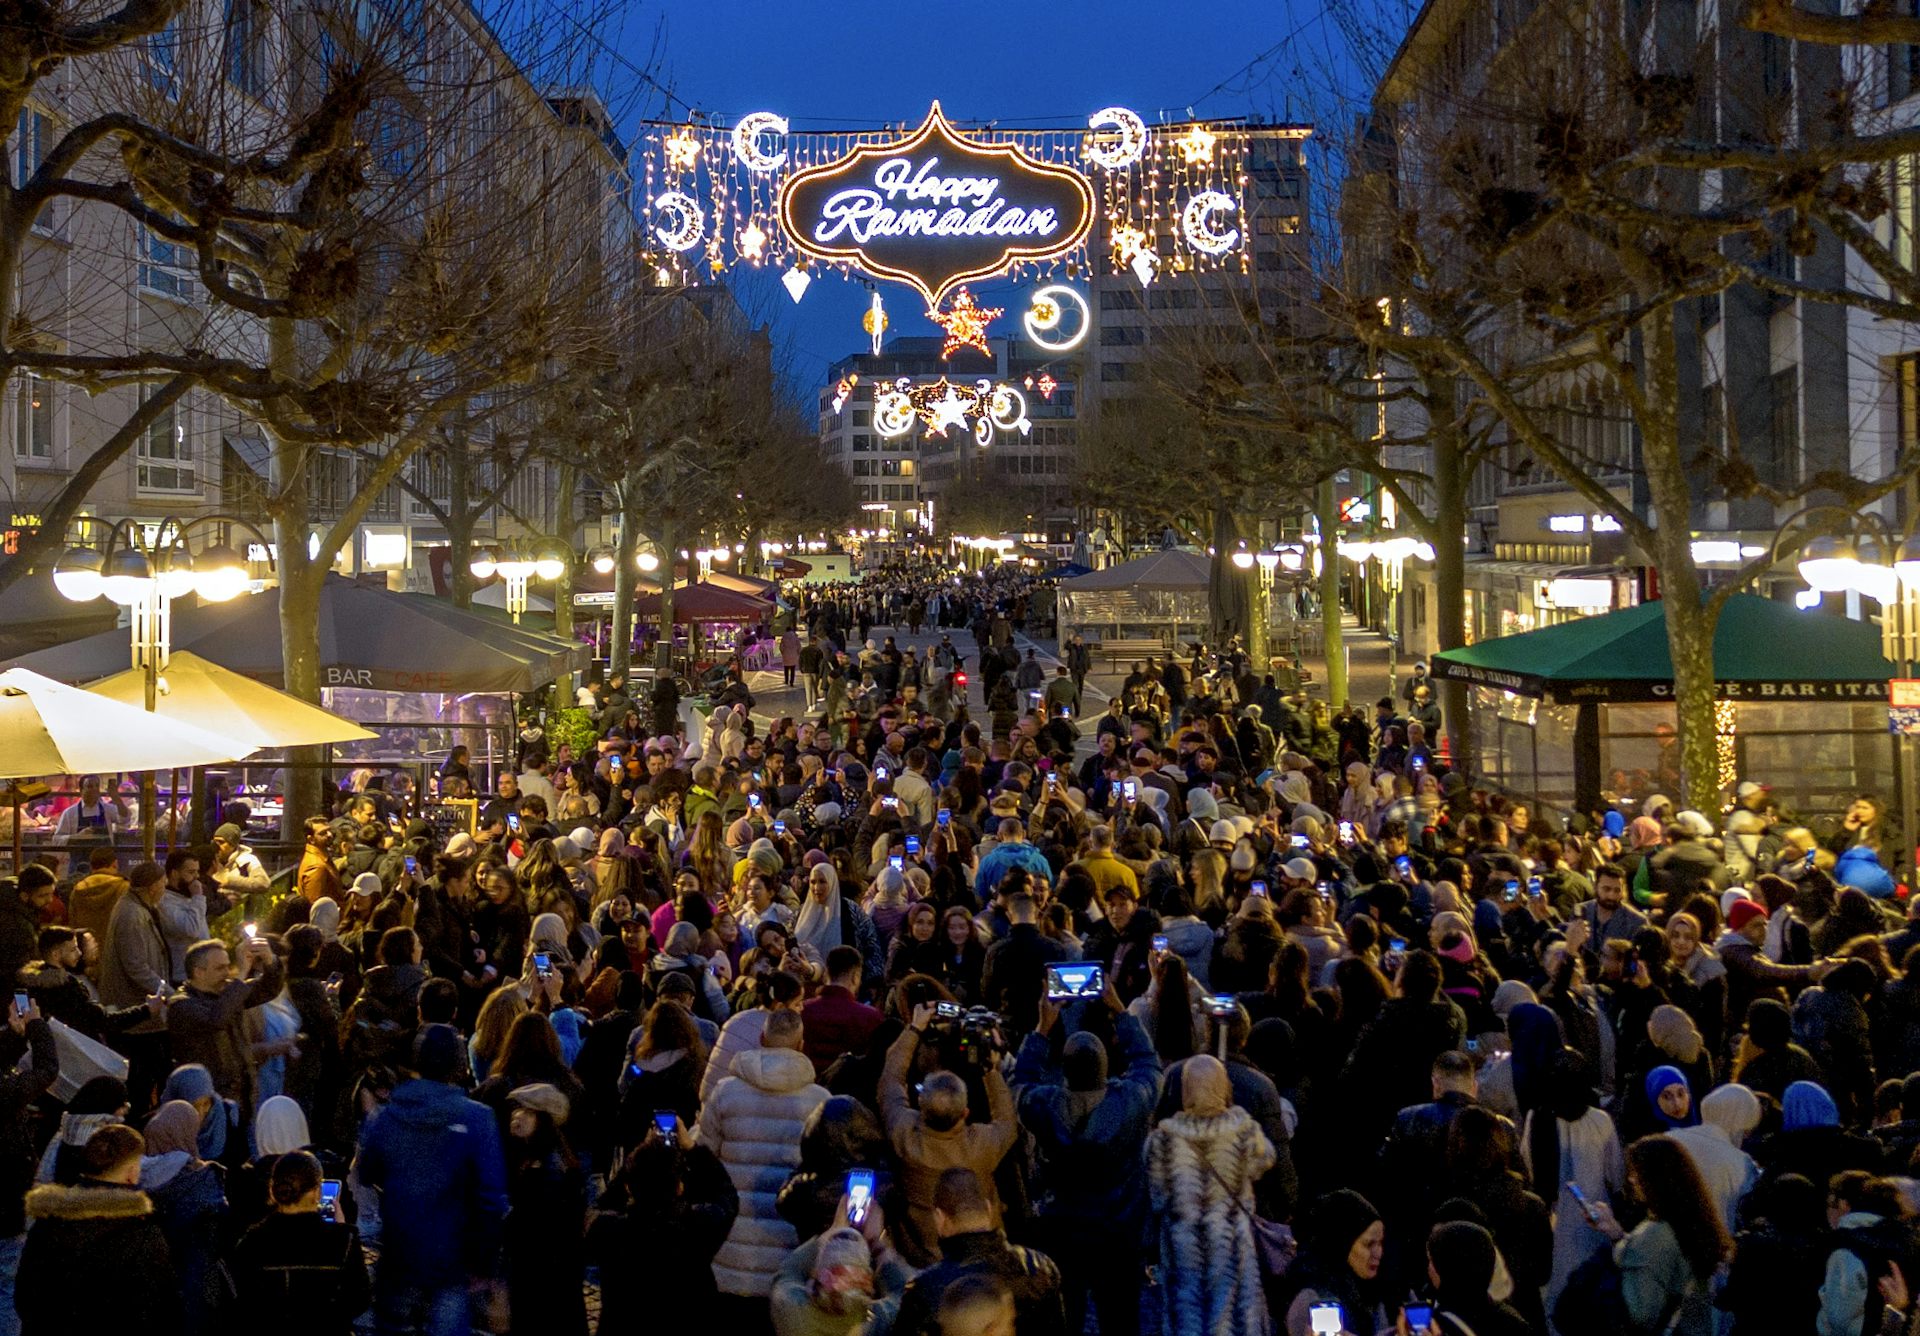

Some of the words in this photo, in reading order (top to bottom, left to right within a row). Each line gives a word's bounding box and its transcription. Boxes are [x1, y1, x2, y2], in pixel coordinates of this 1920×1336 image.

[874, 157, 999, 206] Happy
[814, 189, 1058, 243] Ramadan
[327, 668, 373, 685] BAR
[1760, 683, 1816, 696] BAR
